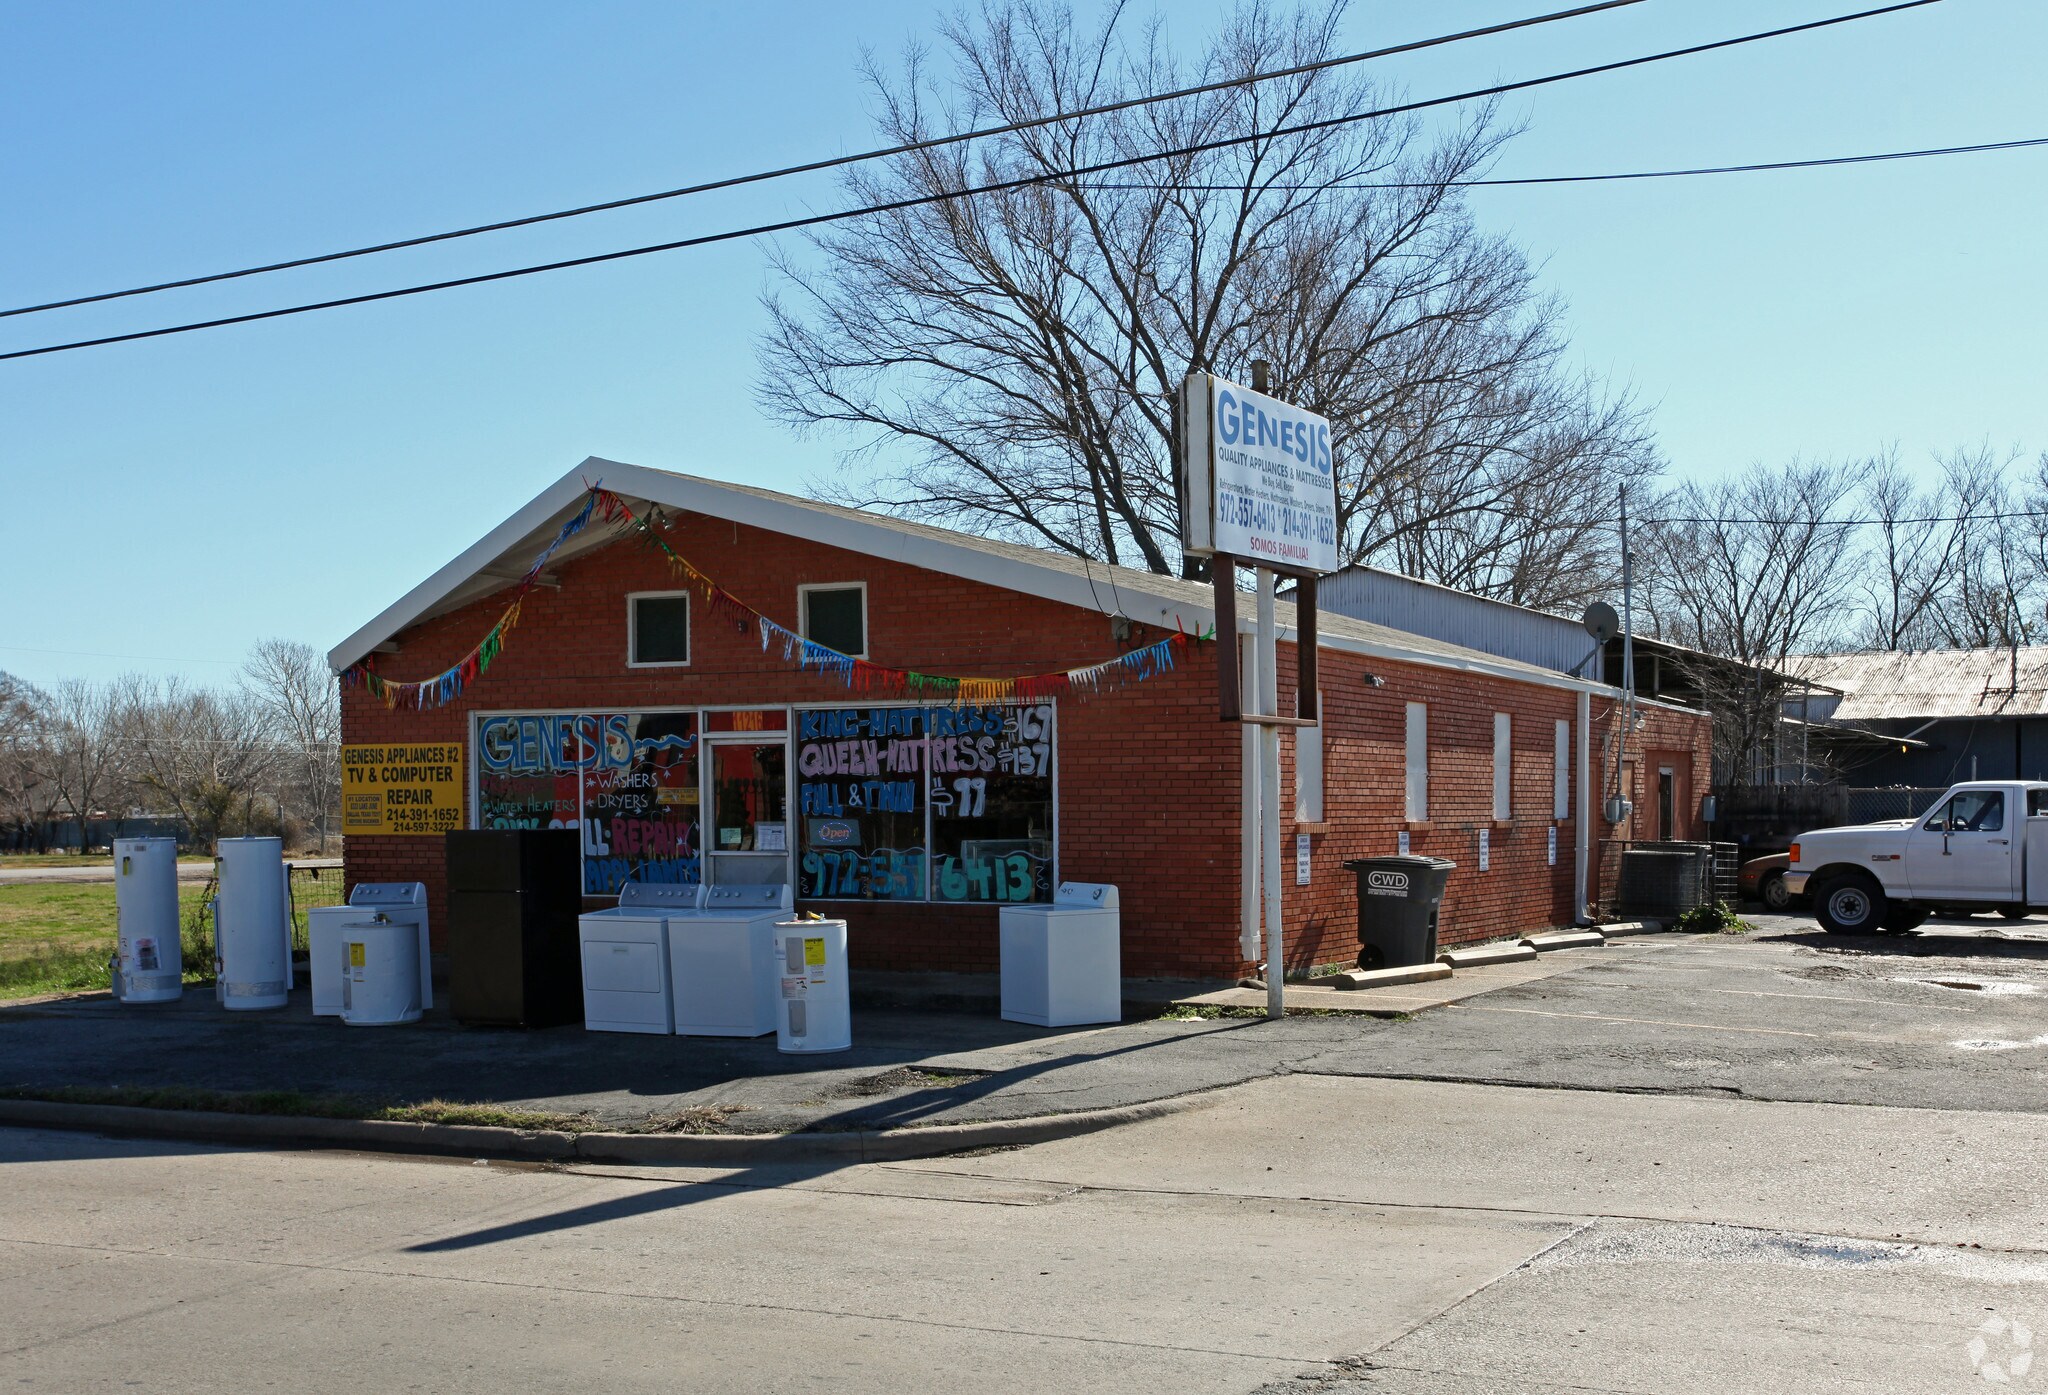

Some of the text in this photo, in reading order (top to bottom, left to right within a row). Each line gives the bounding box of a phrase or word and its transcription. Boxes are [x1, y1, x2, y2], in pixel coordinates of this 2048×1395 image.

[1218, 390, 1331, 475] GENESIS
[1219, 446, 1332, 490] QUALITY APPLIANCES & MATTRESSES
[1284, 481, 1294, 492] Repair
[1220, 492, 1334, 545] 972-557-6413 214-391-1652
[1250, 536, 1308, 560] SOMOS FAMILIA!
[733, 712, 763, 731] 11216
[480, 714, 634, 770] GENESIS
[345, 746, 458, 764] GENESIS APPLIANCES #2
[996, 742, 1050, 778] $137
[348, 766, 453, 783] TV & COMPUTER
[597, 771, 658, 788] WASHERS
[387, 789, 433, 805] REPAIR
[490, 793, 576, 814] WATER HEATERS
[598, 793, 648, 808] DRYERS
[800, 779, 915, 818] FULL & TWIN
[386, 808, 459, 821] 214-391-1652
[394, 822, 456, 832] 214-597-3222
[821, 826, 849, 838] Open
[611, 817, 692, 856] REPAIR
[1372, 874, 1405, 886] CWD
